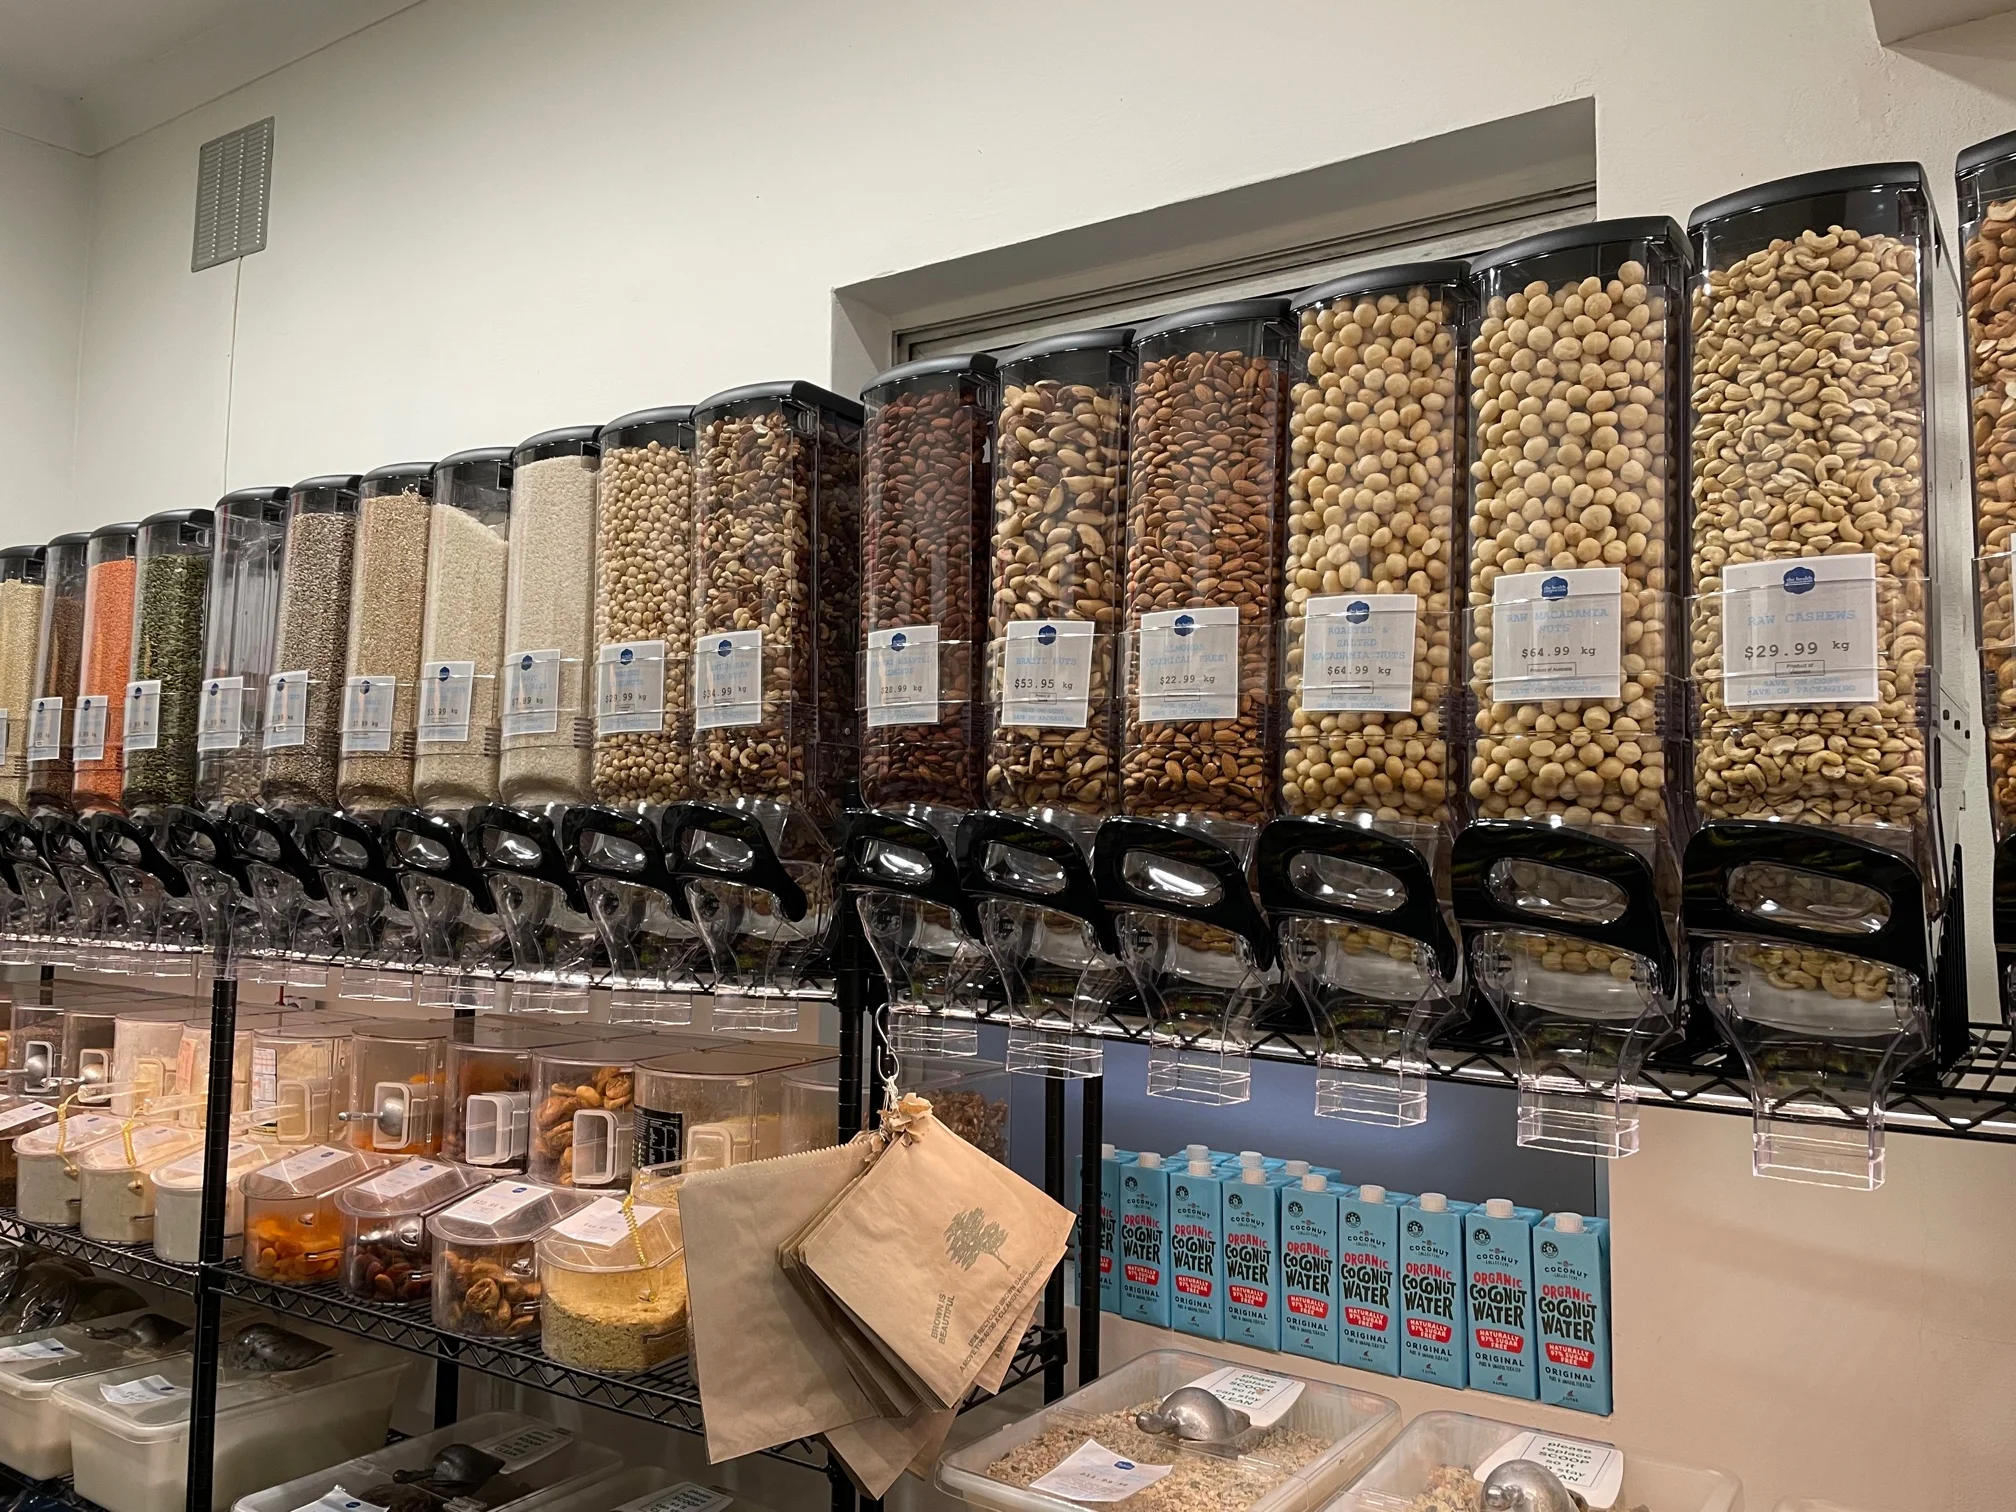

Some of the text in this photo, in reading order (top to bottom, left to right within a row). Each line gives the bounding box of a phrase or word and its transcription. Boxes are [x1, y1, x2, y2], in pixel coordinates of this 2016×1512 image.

[1507, 609, 1609, 623] RAW MACADAMIA
[1747, 610, 1856, 626] RAW CASHEWS
[1539, 624, 1570, 633] NUTS
[1521, 646, 1596, 659] $64.99 kg
[1745, 641, 1849, 660] $29.99 kg
[1328, 666, 1392, 676] $64.99 kg
[1014, 678, 1073, 690] $53.95 kg
[1160, 675, 1215, 685] $22.99 kg
[1124, 1215, 1159, 1228] ORGANIC
[1231, 1216, 1265, 1227] COCONUT
[1122, 1225, 1163, 1245] COCONUT
[1175, 1224, 1212, 1239] ORGANIC
[1290, 1225, 1327, 1236] COCONUT
[1172, 1235, 1216, 1256] COCONUT
[1228, 1233, 1267, 1249] ORGANIC
[1348, 1236, 1386, 1247] COCONUT
[1124, 1240, 1160, 1265] WATER
[1225, 1244, 1271, 1266] COCONUT
[1287, 1242, 1329, 1258] ORGANIC
[1410, 1245, 1449, 1257] COCONUT
[1174, 1251, 1213, 1276] WATER
[1284, 1253, 1333, 1276] COCONUT
[1344, 1252, 1388, 1269] ORGANIC
[1477, 1254, 1519, 1265] COCONUT
[1227, 1260, 1269, 1286] WATER
[1341, 1264, 1392, 1288] COCONUT
[1406, 1263, 1452, 1280] ORGANIC
[1545, 1267, 1588, 1278] COCONUT
[1285, 1269, 1330, 1296] WATER
[1402, 1274, 1456, 1299] COCONUT
[1474, 1272, 1522, 1288] ORGANIC
[1125, 1285, 1159, 1297] ORIGINAL
[1232, 1286, 1263, 1297] NATURALLY
[1343, 1281, 1389, 1308] WATER
[1470, 1284, 1527, 1308] COCONUT
[1542, 1285, 1592, 1303] ORGANIC
[1175, 1297, 1212, 1309] ORIGINAL
[1241, 1297, 1255, 1305] FREE
[1244, 1294, 1263, 1302] SUGAR
[1291, 1296, 1324, 1307] NATURALLY
[1304, 1303, 1324, 1312] SUGAR
[1404, 1291, 1453, 1320] WATER
[1539, 1297, 1597, 1322] COCONUT
[931, 1293, 946, 1339] BROWN IS
[939, 1295, 955, 1345] BEAUTIFUL
[977, 1305, 1000, 1335] RECYCLED
[1229, 1307, 1268, 1320] ORIGINAL
[1349, 1308, 1383, 1320] NATURALLY
[1472, 1301, 1524, 1329] WATER
[1286, 1317, 1328, 1331] ORIGINAL
[1358, 1320, 1373, 1328] FREE
[1362, 1316, 1383, 1325] SUGAR
[1410, 1319, 1447, 1331] NATURALLY
[1344, 1329, 1388, 1344] ORIGINAL
[1421, 1332, 1436, 1340] FREE
[1425, 1327, 1446, 1337] SUGAR
[1480, 1330, 1519, 1342] NATURALLY
[1541, 1315, 1595, 1345] WATER
[1406, 1341, 1452, 1356] ORIGINAL
[1491, 1342, 1507, 1350] FREE
[1496, 1338, 1518, 1347] SUGAR
[1550, 1343, 1589, 1356] NATURALLY
[1476, 1352, 1524, 1367] ORIGINAL
[1560, 1357, 1577, 1365] FREE
[1565, 1352, 1588, 1362] SUGAR
[1242, 1374, 1277, 1384] please
[1545, 1367, 1595, 1382] ORIGINAL
[1235, 1377, 1274, 1388] replace
[1214, 1394, 1253, 1405] CLEAN
[1542, 1447, 1591, 1459] replace
[1548, 1442, 1591, 1453] please
[1539, 1452, 1589, 1463] SCOOP
[1558, 1468, 1585, 1476] stay
